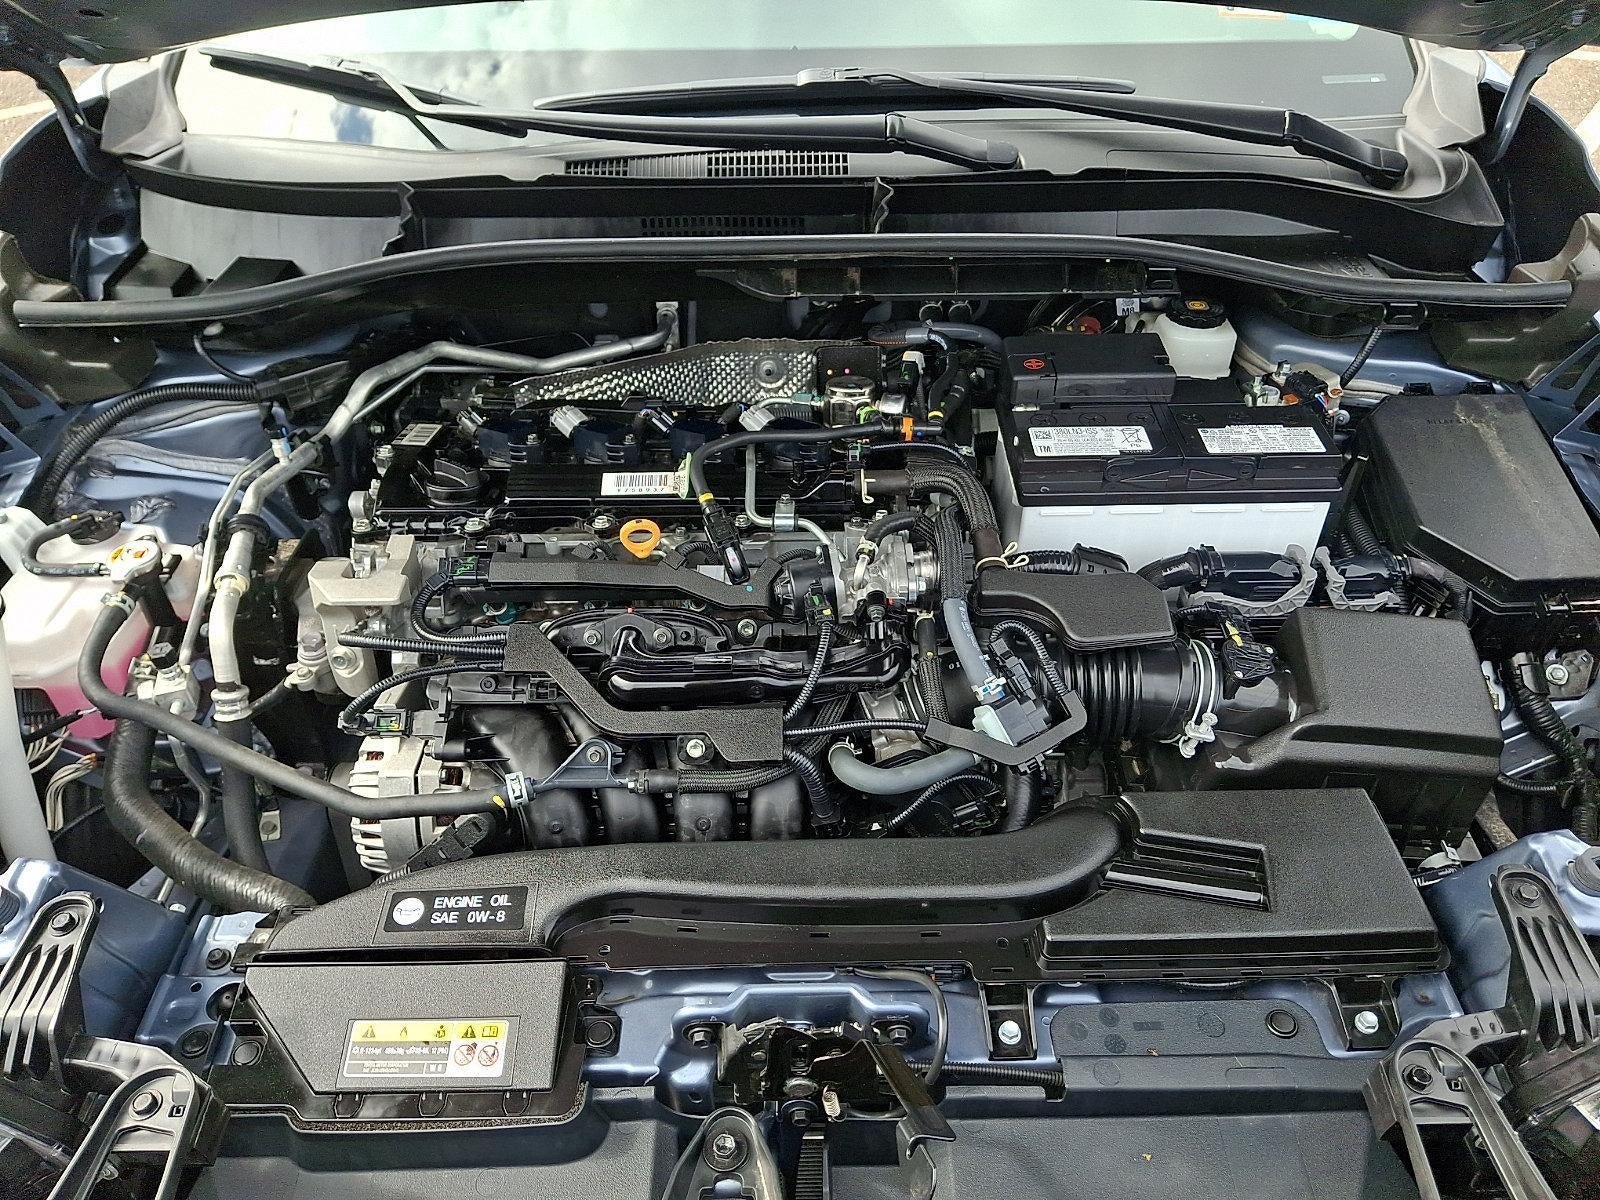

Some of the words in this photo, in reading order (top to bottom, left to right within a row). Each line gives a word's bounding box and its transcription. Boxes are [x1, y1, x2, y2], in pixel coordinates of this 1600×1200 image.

[1038, 445, 1052, 453] TM
[433, 895, 483, 909] ENGINE
[490, 894, 512, 907] OIL
[430, 911, 460, 924] SAE
[466, 910, 506, 923] 0W-8
